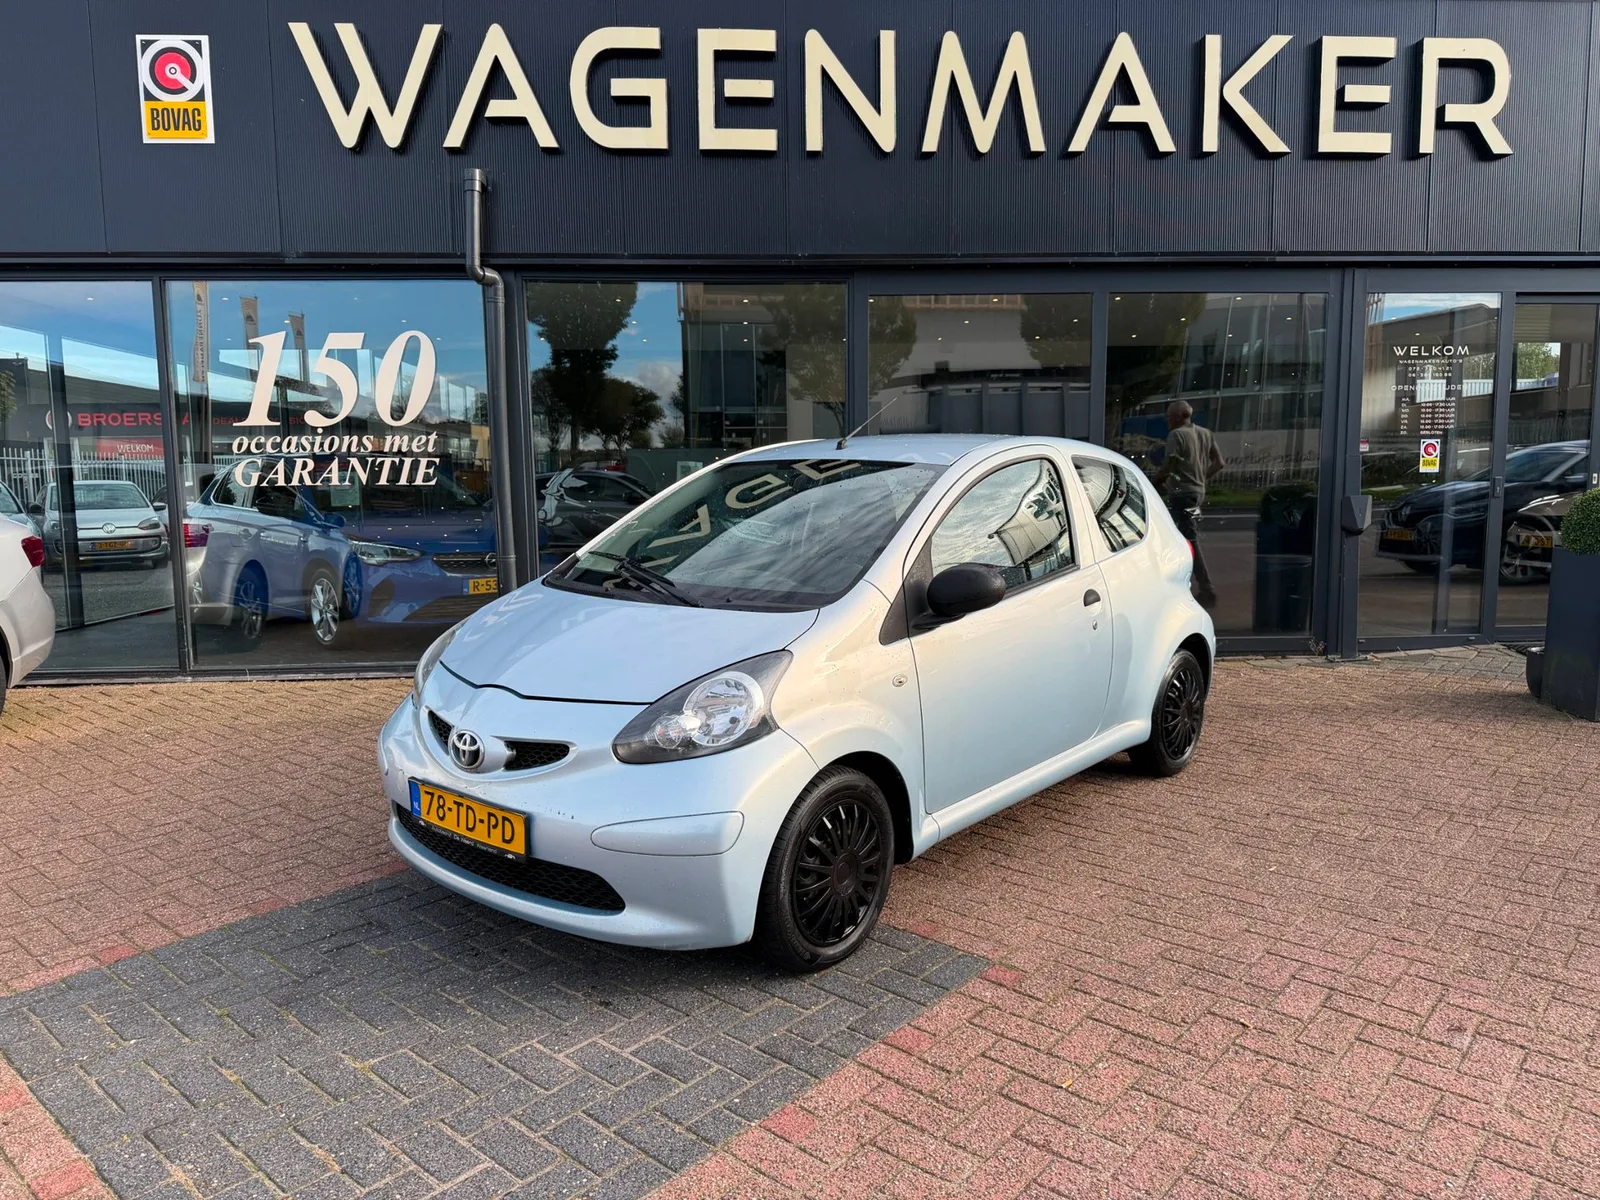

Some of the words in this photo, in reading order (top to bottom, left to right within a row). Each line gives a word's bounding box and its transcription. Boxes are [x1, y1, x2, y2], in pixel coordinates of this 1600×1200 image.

[287, 22, 1513, 156] WAGENMAKER
[150, 107, 202, 132] BOVAG
[1393, 345, 1470, 356] WELKOM
[233, 330, 436, 427] 150
[117, 443, 154, 453] WELKOM
[232, 427, 374, 454] occasions
[384, 431, 438, 453] met
[234, 457, 440, 488] GARANTIE
[1422, 459, 1437, 467] BOVAG
[472, 579, 497, 592] R-53
[424, 790, 515, 845] 78-TD-PD
